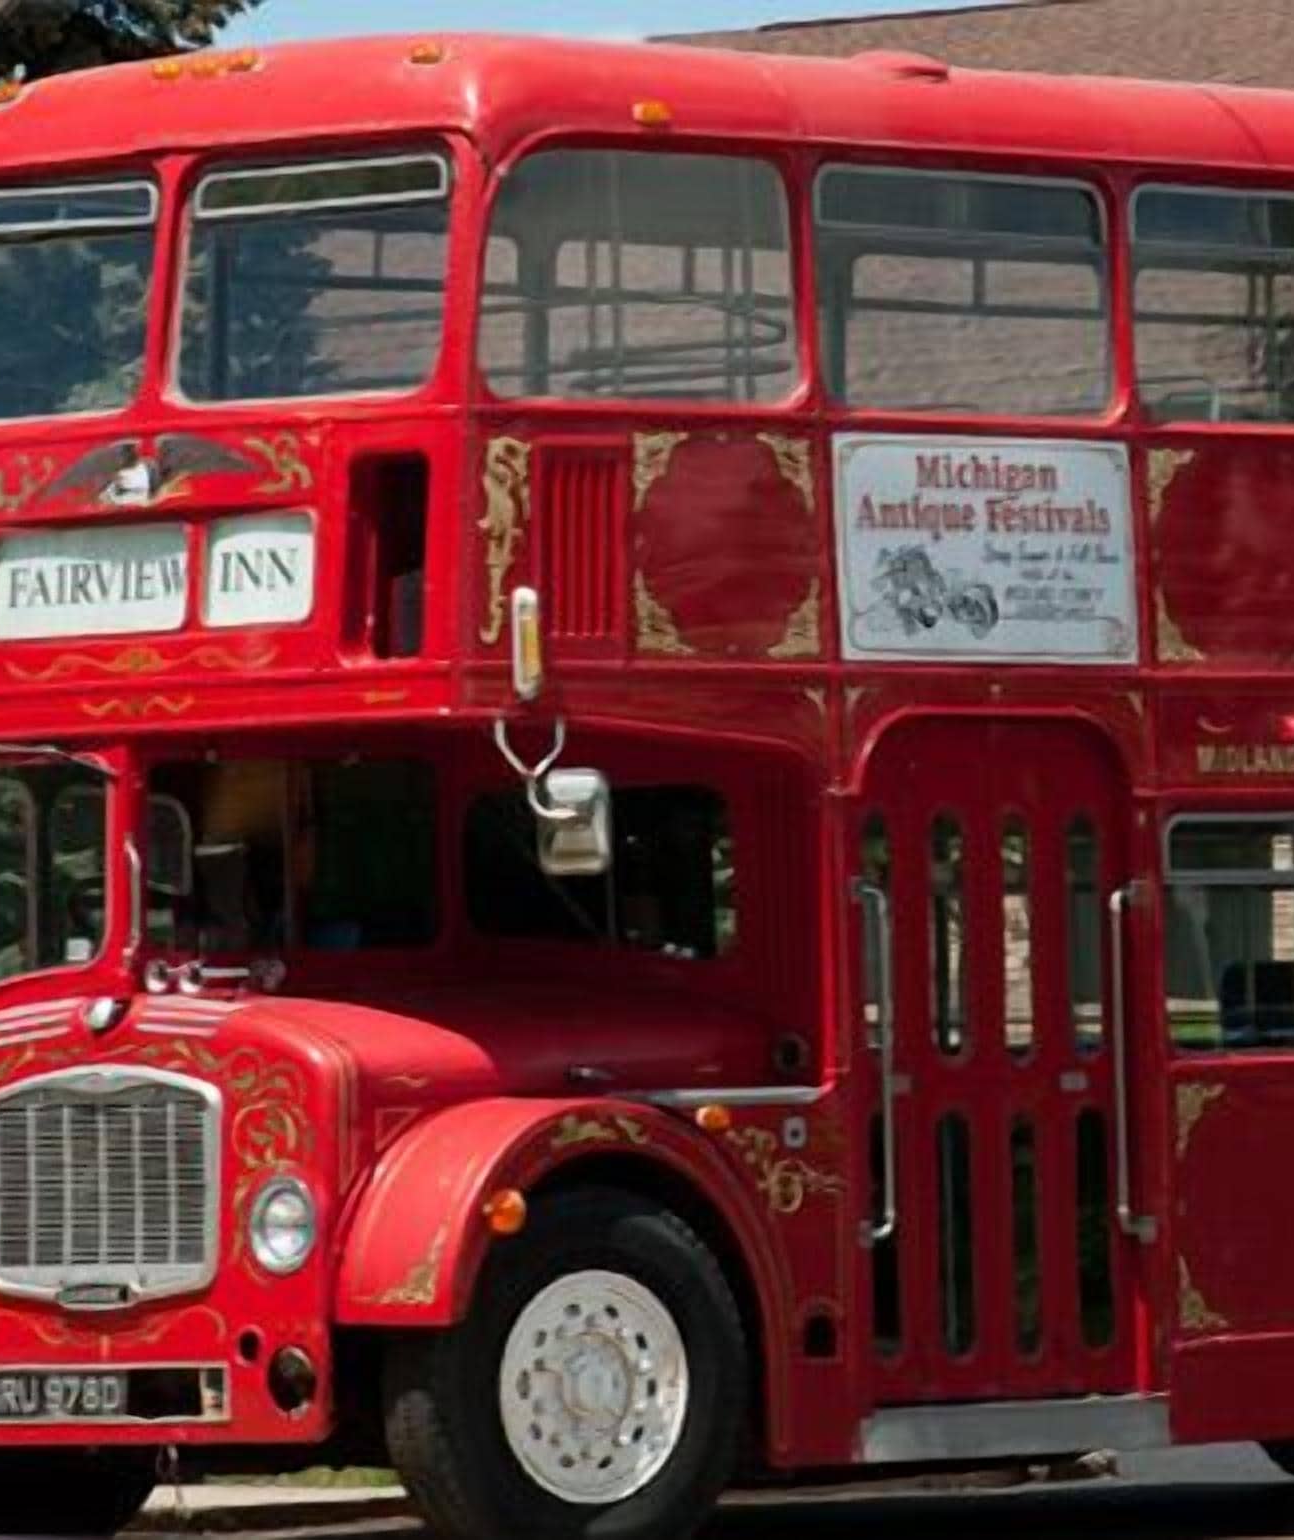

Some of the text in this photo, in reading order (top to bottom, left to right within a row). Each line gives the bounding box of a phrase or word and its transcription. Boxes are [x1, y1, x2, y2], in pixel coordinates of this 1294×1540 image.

[916, 455, 1058, 492] Michigan
[856, 494, 1112, 541] Antique Festivals
[7, 547, 298, 609] FAIRVIEW INN
[44, 1376, 120, 1411] 978D
